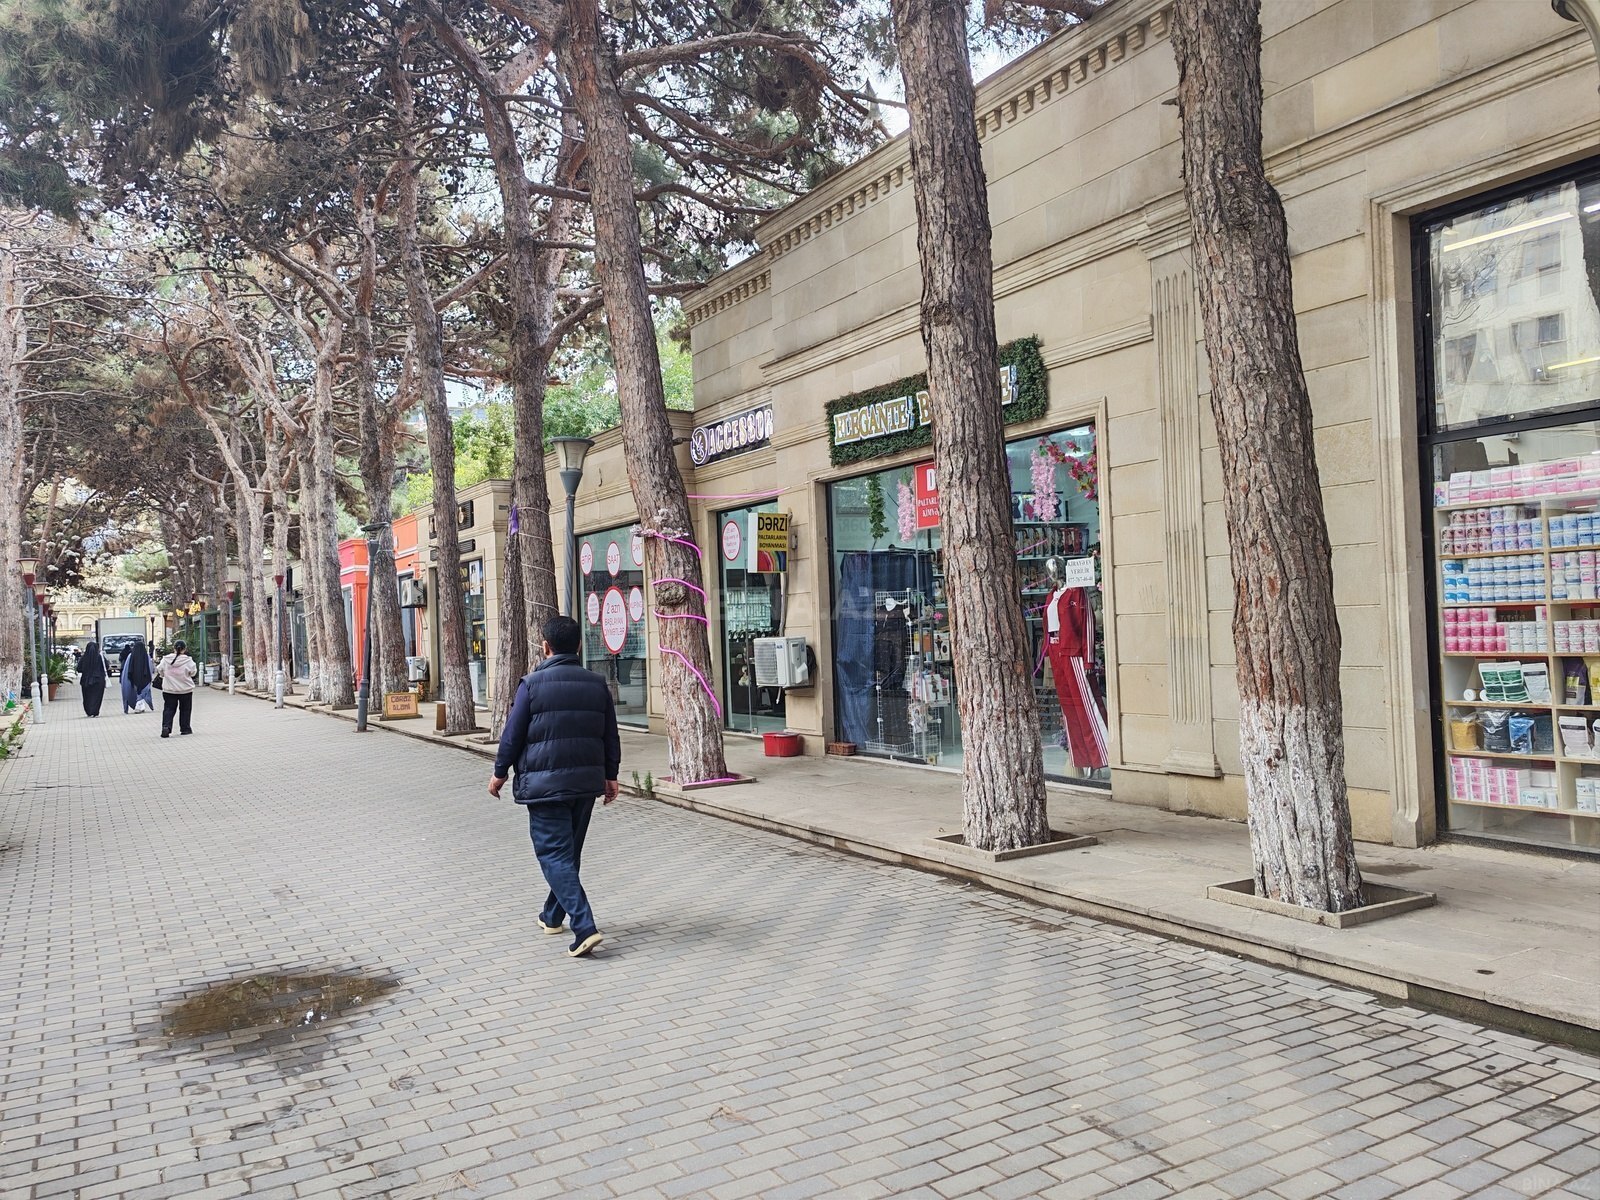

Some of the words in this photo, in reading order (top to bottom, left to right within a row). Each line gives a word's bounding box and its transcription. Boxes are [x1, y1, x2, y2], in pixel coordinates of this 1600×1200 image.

[833, 395, 911, 446] ELEGANTE
[757, 513, 788, 531] DƏRZİ
[606, 602, 611, 615] 2
